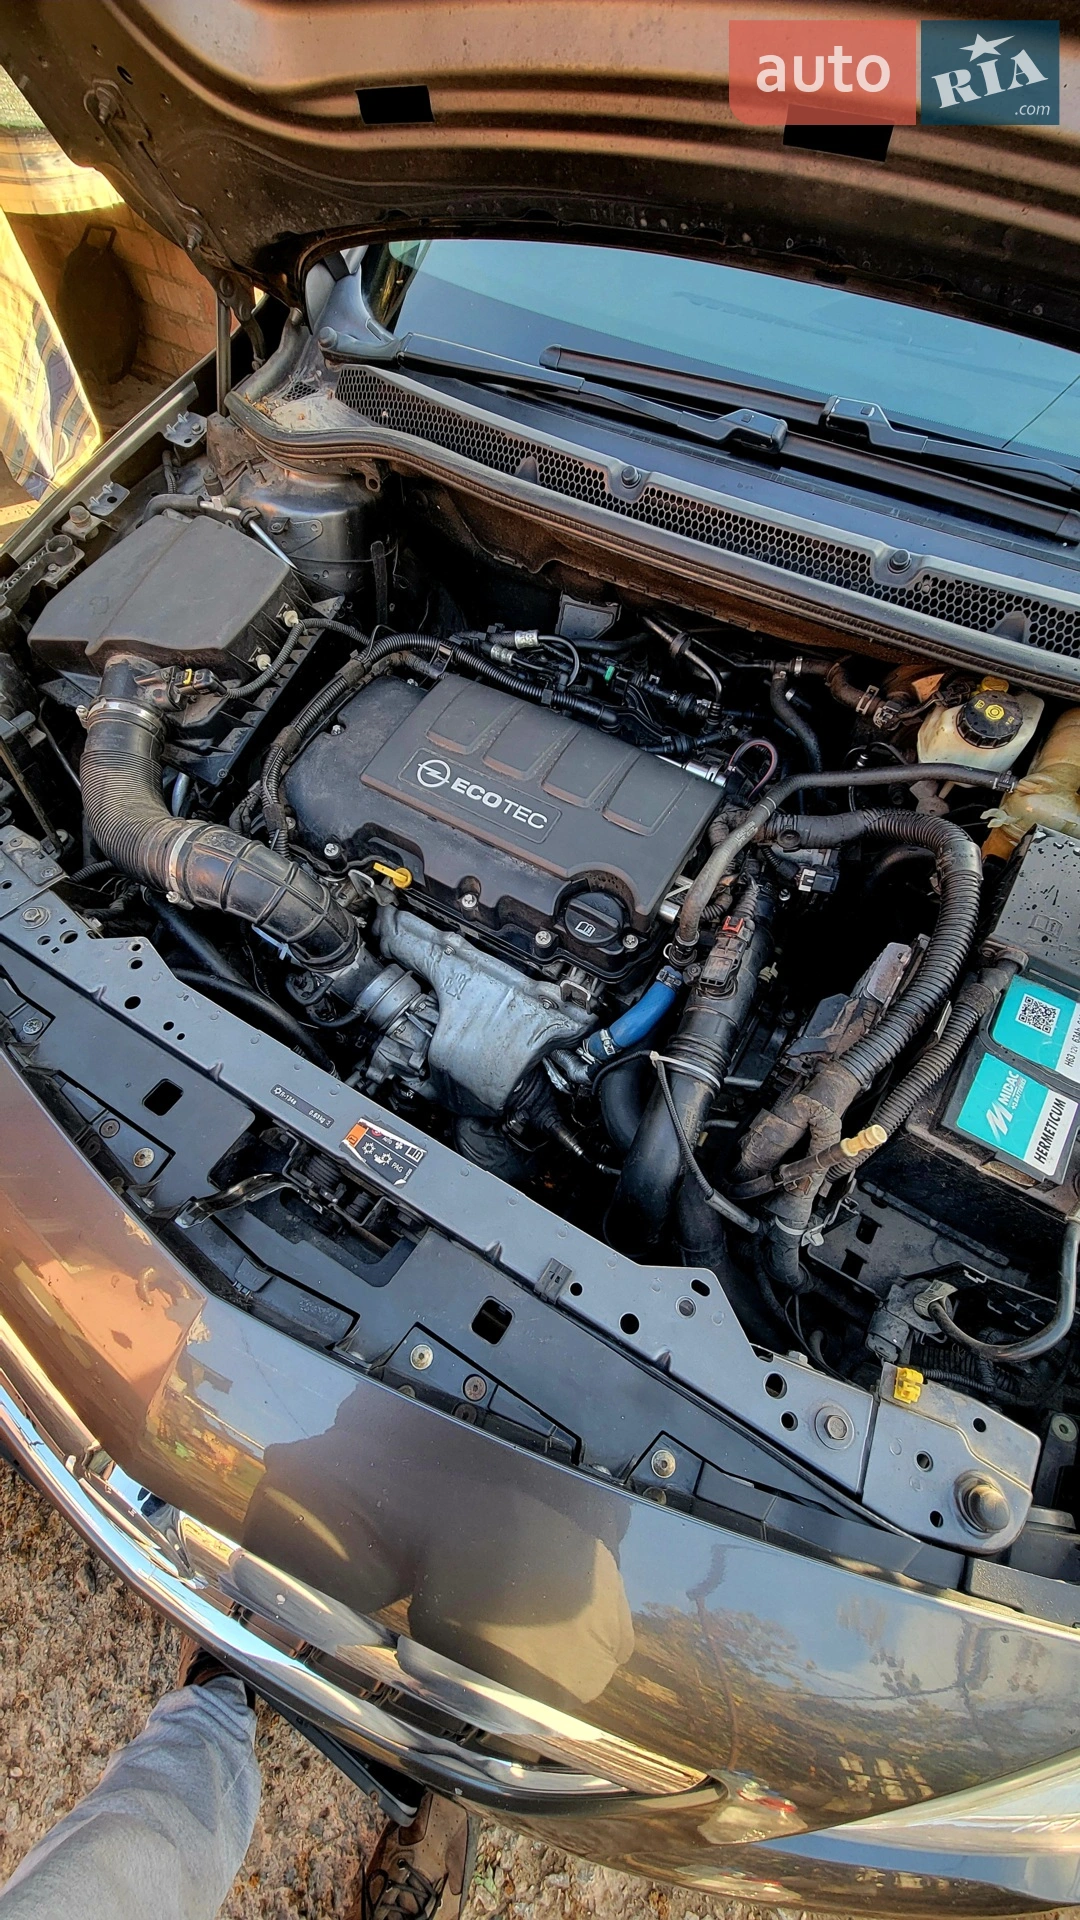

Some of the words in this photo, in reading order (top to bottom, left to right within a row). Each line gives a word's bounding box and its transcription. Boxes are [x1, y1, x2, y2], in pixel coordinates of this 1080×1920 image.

[450, 777, 548, 830] ECOTEC
[1064, 1053, 1076, 1068] H63
[998, 1070, 1020, 1106] MIDAC
[1033, 1097, 1067, 1165] HERMETICUM
[391, 1162, 404, 1173] PAG
